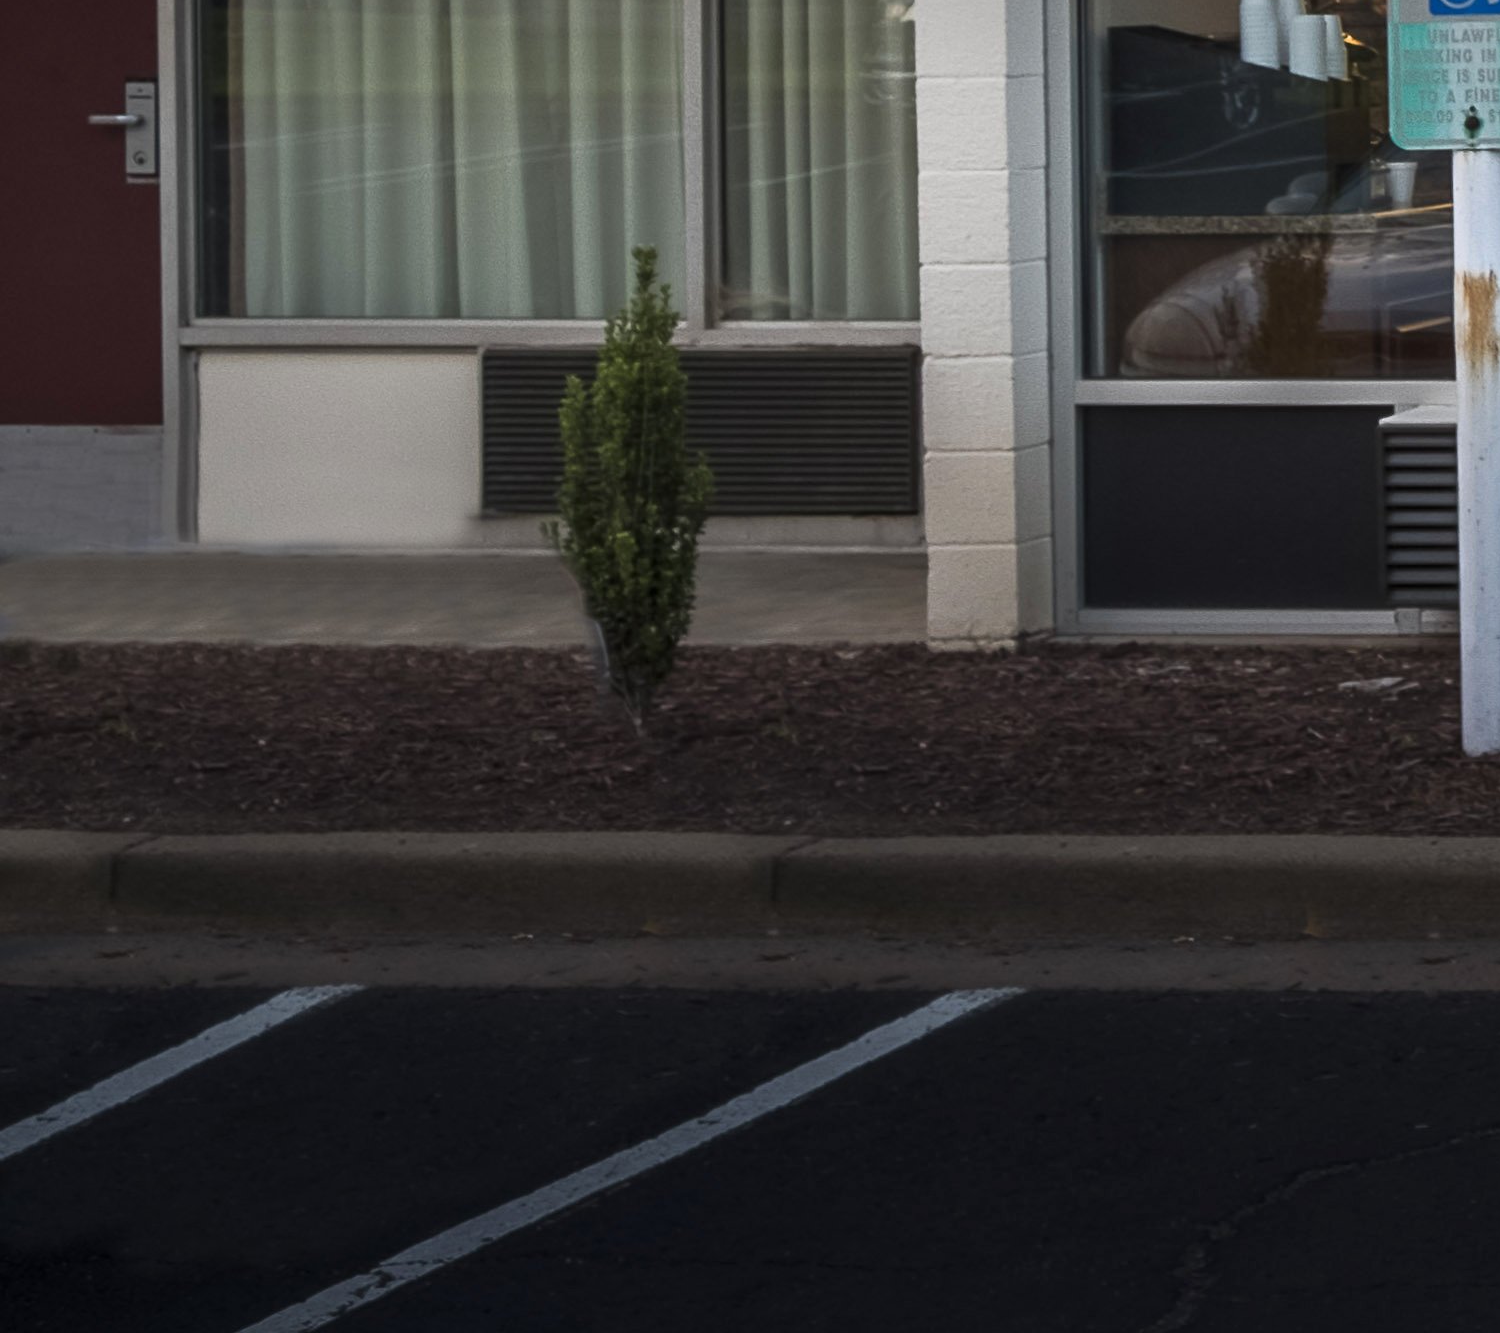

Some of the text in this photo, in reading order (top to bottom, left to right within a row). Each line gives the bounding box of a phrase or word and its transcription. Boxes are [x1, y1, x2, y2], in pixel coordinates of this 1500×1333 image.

[1403, 48, 1473, 64] KING
[1481, 48, 1497, 64] IN
[1457, 68, 1471, 83] IS
[1446, 88, 1456, 103] A
[1465, 87, 1500, 103] FINE
